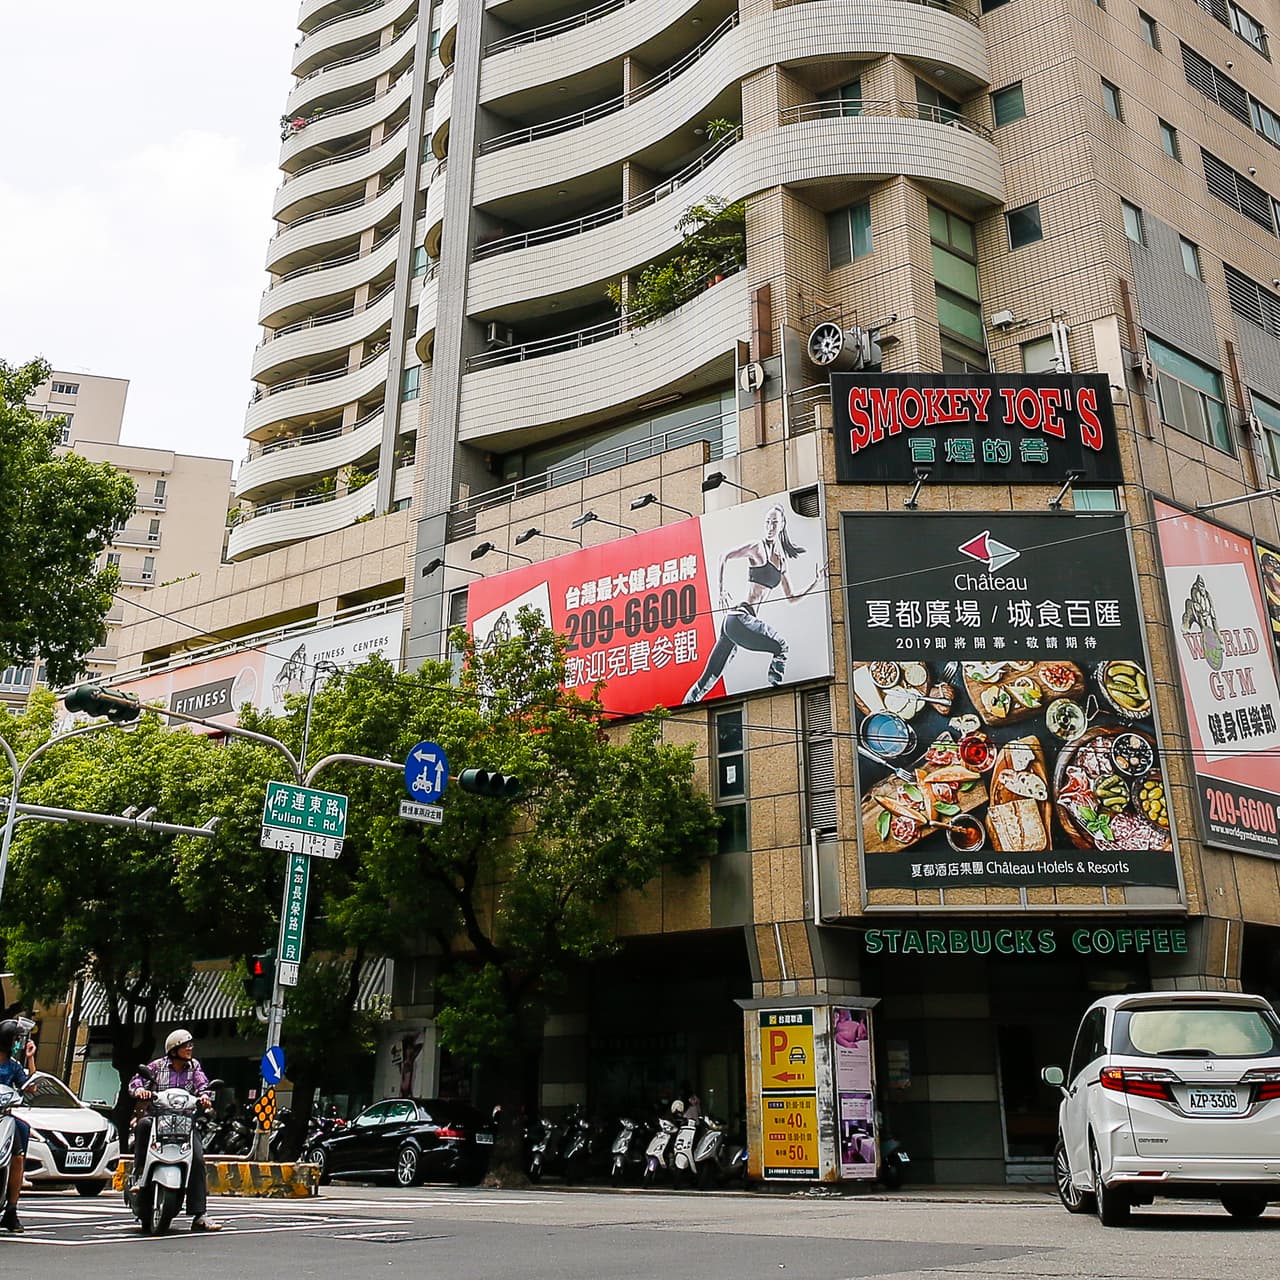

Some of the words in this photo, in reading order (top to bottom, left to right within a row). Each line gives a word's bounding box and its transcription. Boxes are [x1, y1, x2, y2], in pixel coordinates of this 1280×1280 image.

[848, 386, 991, 454] SMOKEY
[1000, 387, 1103, 451] JOE'S
[908, 438, 1049, 463] 冒煙的喬
[565, 554, 697, 610] 台灣最大健身品牌
[954, 573, 1028, 591] Château
[565, 584, 697, 652] 209-6600
[866, 600, 981, 628] 夏都廣場
[1007, 599, 1122, 628] 城食百匯
[313, 647, 345, 663] FITNESS
[353, 636, 389, 653] CENTERS
[564, 629, 698, 689] 歡迎免費參觀
[1209, 667, 1257, 701] GYM
[176, 688, 227, 713] FITNESS
[1208, 704, 1277, 745] 健身俱樂部
[273, 789, 340, 818] 府連東路
[1206, 788, 1277, 834] 209-6600
[307, 816, 317, 828] E.
[323, 820, 338, 832] Rd.
[911, 861, 984, 877] 夏都酒店集團
[986, 860, 1035, 876] Château
[1037, 860, 1074, 874] Hotels
[1076, 862, 1086, 873] &
[1088, 859, 1130, 874] Resorts
[285, 885, 302, 960] 長榮路一段
[865, 928, 1056, 955] STARBUCKS
[1072, 929, 1188, 954] COFFEE
[770, 1030, 788, 1066] P
[787, 1113, 802, 1128] 40
[789, 1145, 804, 1160] 50
